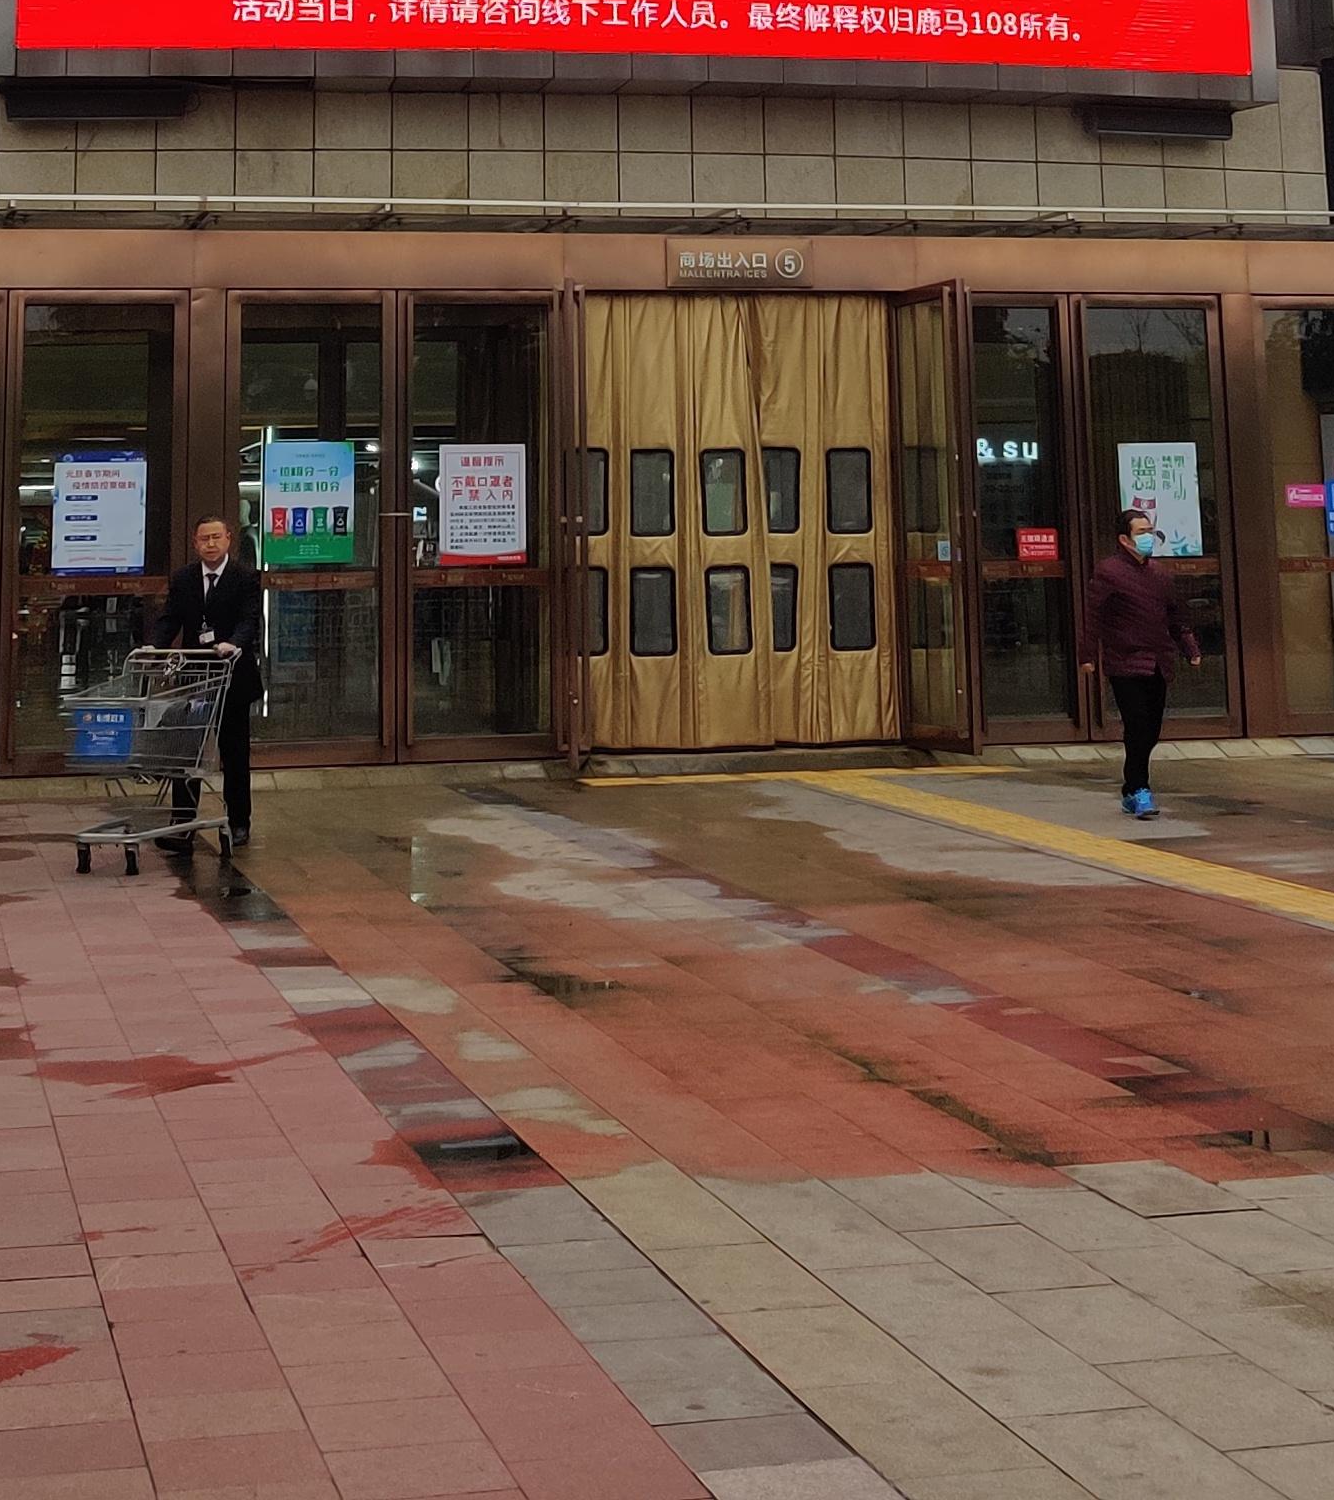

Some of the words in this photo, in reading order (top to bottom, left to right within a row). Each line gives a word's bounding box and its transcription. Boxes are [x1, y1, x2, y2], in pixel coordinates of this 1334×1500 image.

[679, 251, 768, 269] 商场出入口
[451, 475, 514, 488] 不戴口罩者
[451, 489, 514, 502] 严禁入内
